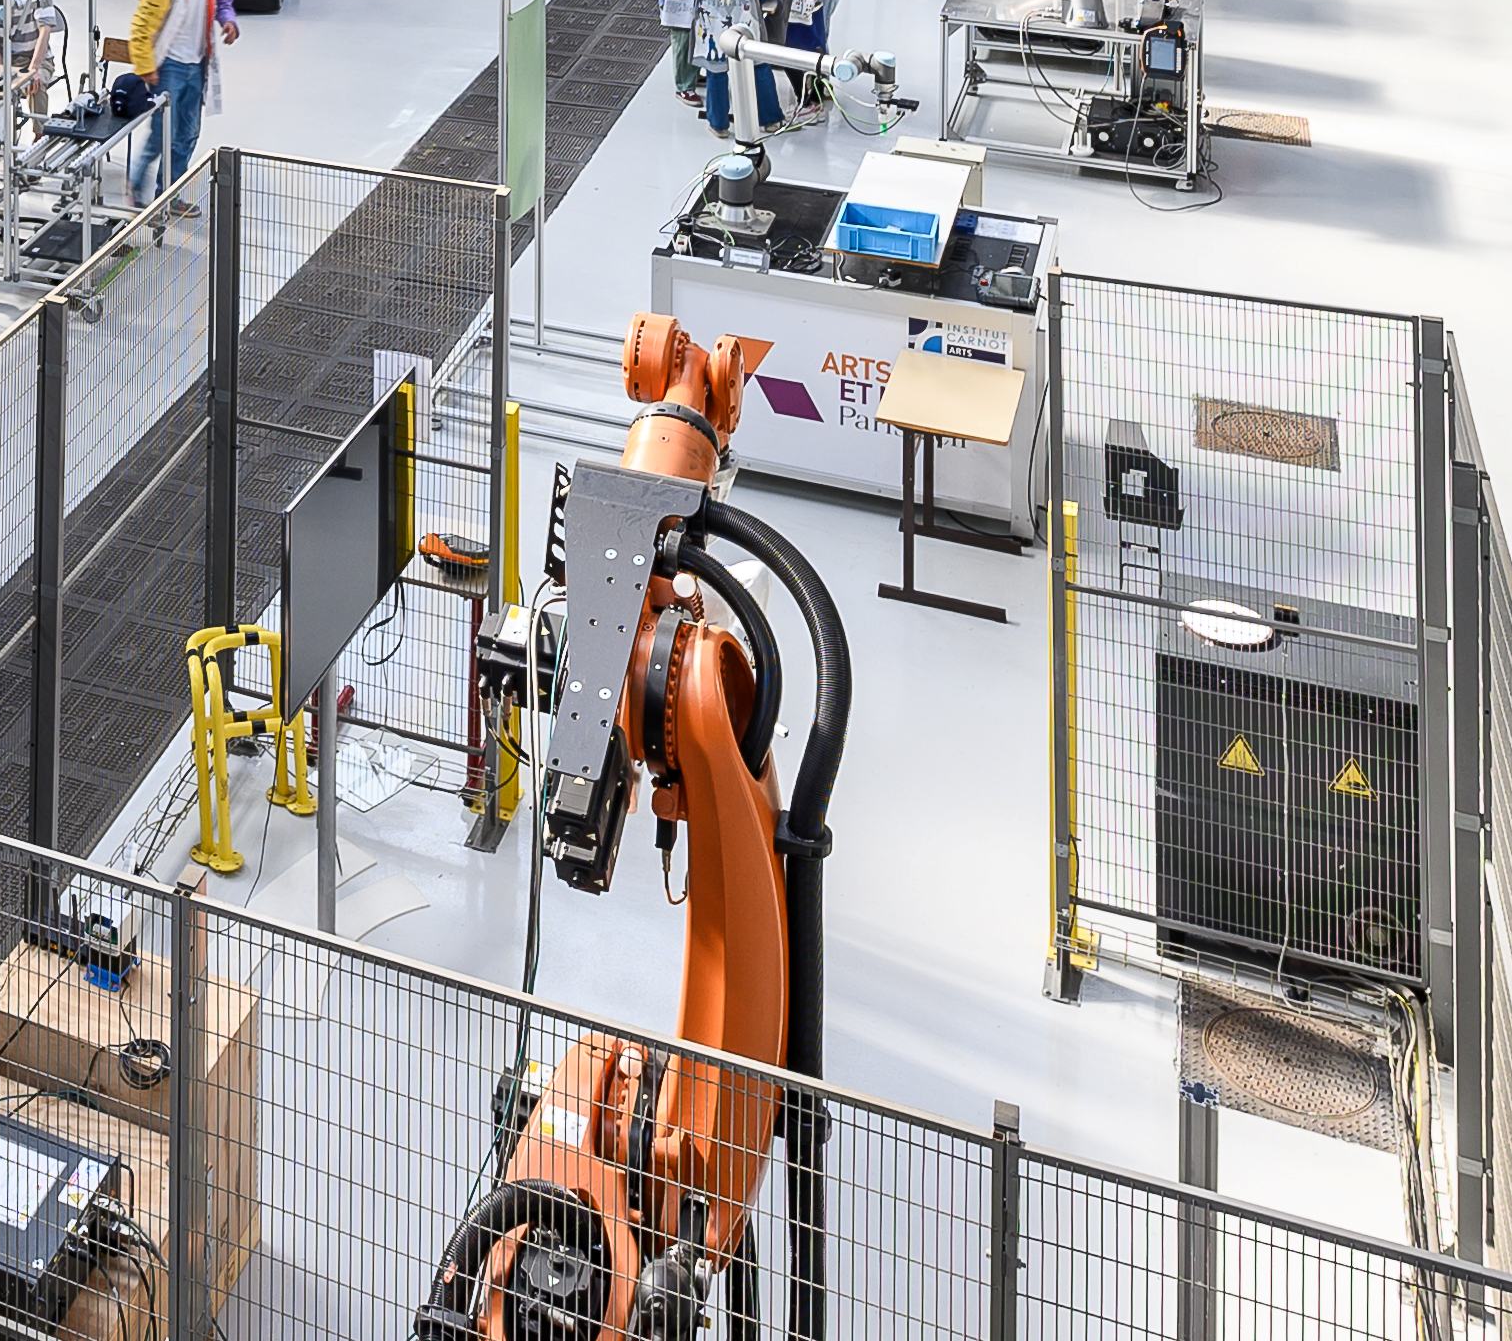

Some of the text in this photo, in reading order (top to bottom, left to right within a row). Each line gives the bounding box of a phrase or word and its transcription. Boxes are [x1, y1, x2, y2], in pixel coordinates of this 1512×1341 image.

[946, 323, 1008, 340] INSTITUT
[946, 332, 1007, 352] CARNOT
[948, 346, 974, 358] ARTS
[820, 350, 892, 384] ARTS
[839, 379, 874, 405] ET
